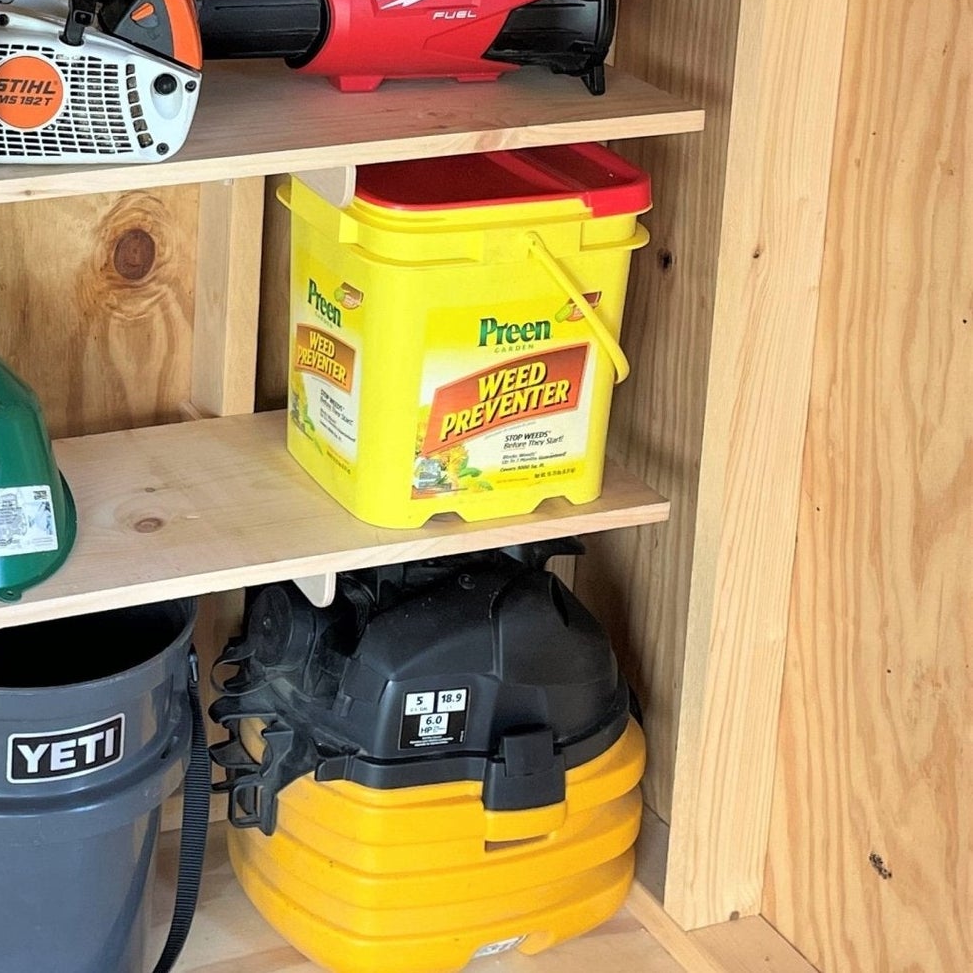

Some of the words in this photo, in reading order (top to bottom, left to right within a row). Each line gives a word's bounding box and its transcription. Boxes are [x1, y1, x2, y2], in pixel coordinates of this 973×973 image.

[433, 10, 477, 20] FUEL
[308, 278, 342, 328] Preen
[477, 316, 551, 348] Preen
[310, 330, 335, 359] WEED
[494, 344, 535, 354] GARDEN
[297, 345, 347, 384] PREVENTER
[478, 361, 547, 403] WEED
[439, 379, 572, 442] PREVENTER
[503, 441, 527, 450] Before
[529, 439, 545, 447] They
[505, 433, 523, 442] STOP
[524, 431, 548, 440] WEEDS
[416, 696, 424, 705] 5
[441, 693, 463, 703] 18.9
[421, 726, 433, 734] HP
[425, 715, 443, 725] 6.0
[17, 727, 115, 773] YETI
